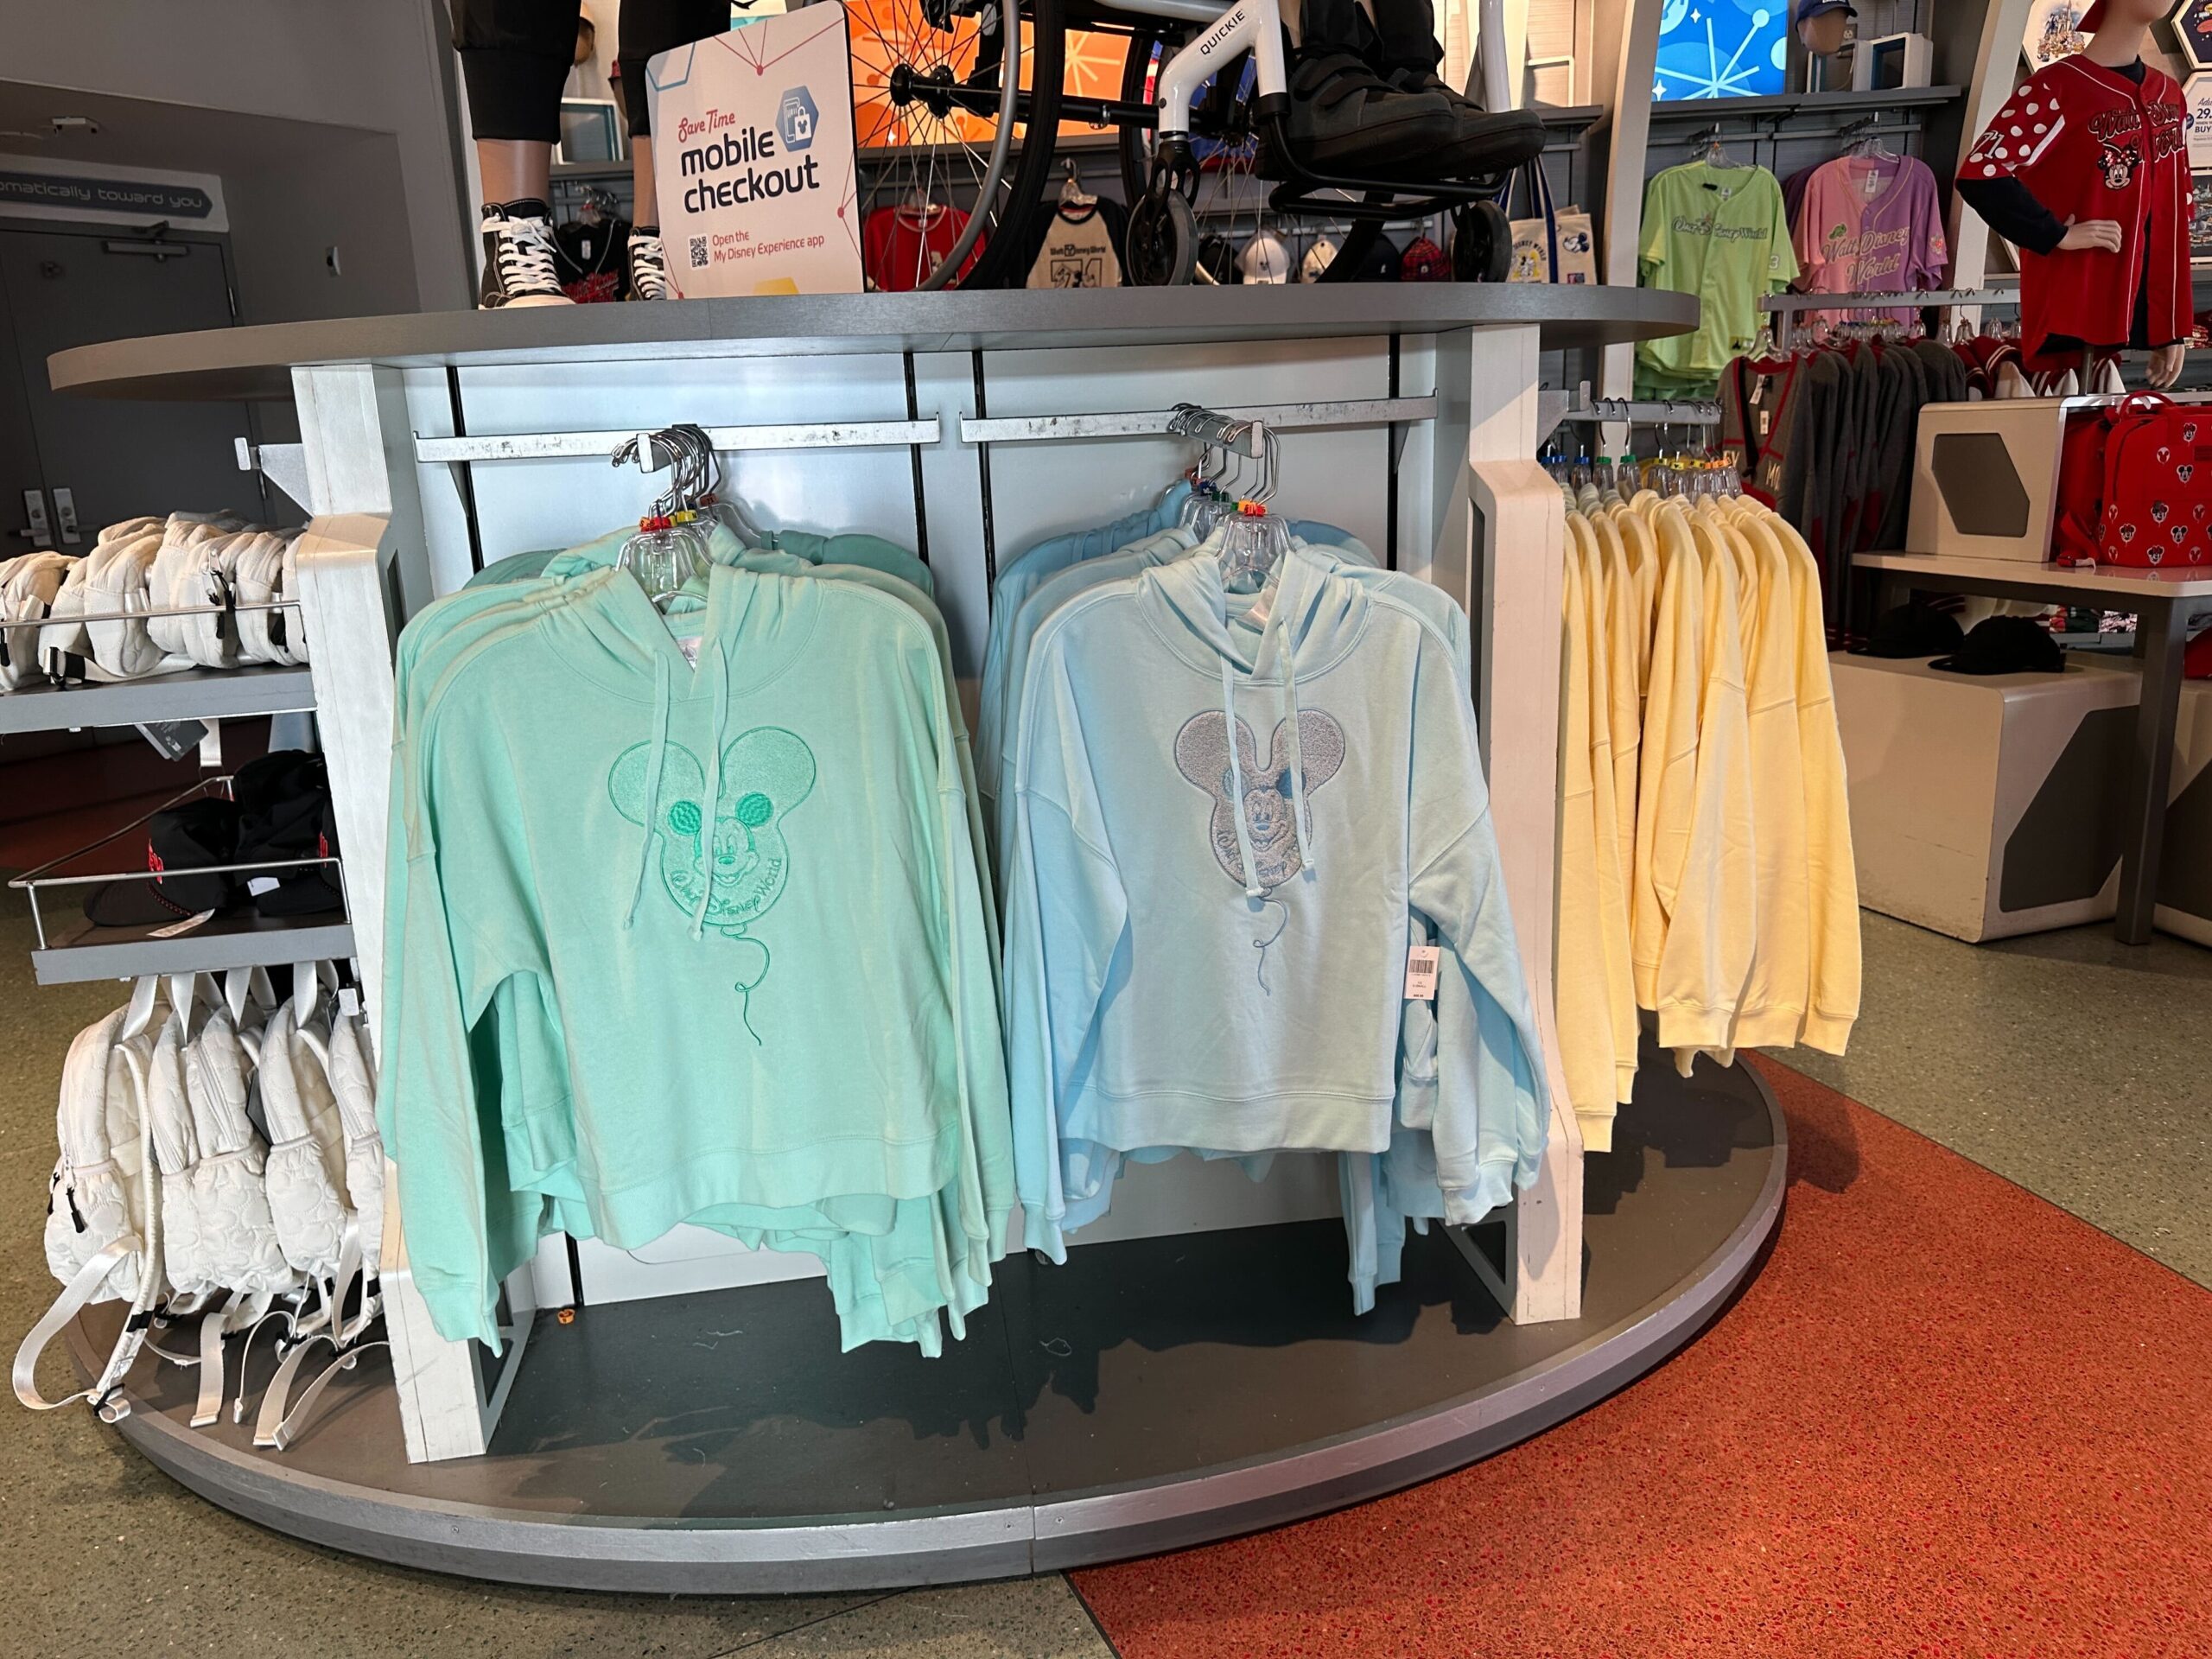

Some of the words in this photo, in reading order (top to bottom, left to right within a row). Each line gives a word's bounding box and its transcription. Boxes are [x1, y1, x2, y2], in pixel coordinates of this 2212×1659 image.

[1200, 10, 1246, 56] QUICKIE
[678, 118, 706, 143] Save
[706, 109, 736, 134] Time
[681, 126, 775, 176] mobile
[98, 188, 164, 204] toward
[169, 199, 202, 208] you
[684, 155, 820, 213] checkout
[712, 233, 734, 247] Open
[735, 230, 750, 242] the
[714, 250, 727, 264] My
[728, 246, 756, 260] Disney
[757, 238, 805, 256] Experience
[807, 234, 825, 249] app
[1821, 238, 1859, 265] Walt
[1859, 226, 1910, 256] Disney
[1846, 253, 1902, 285] World
